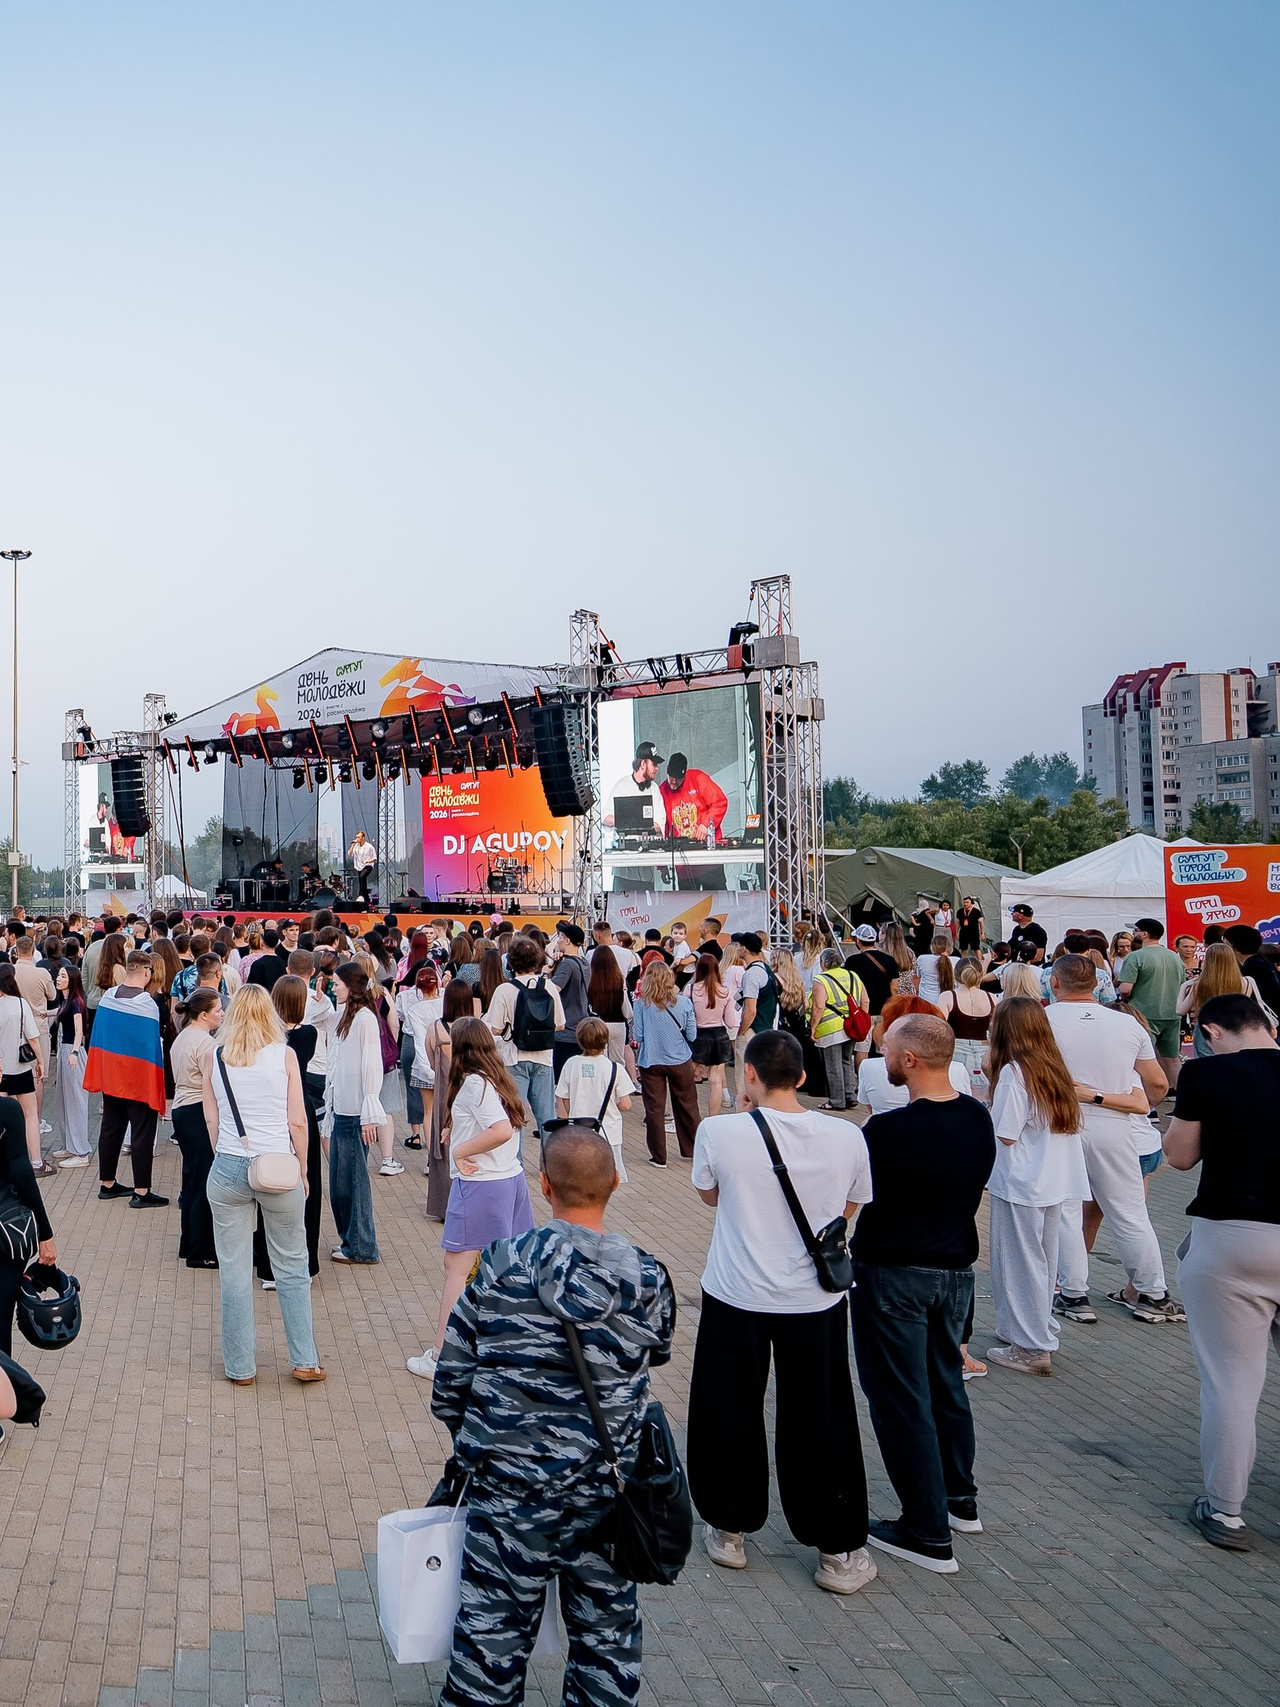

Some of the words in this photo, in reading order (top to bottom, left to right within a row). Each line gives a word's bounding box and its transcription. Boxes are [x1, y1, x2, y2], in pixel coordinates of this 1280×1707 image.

[335, 659, 363, 677] СУРГУТ
[297, 708, 322, 721] 2026
[429, 810, 448, 819] 2026
[443, 834, 465, 855] DJ
[471, 830, 569, 855] AGUPOV
[1177, 852, 1217, 864] СУРГУТ
[1178, 863, 1211, 873] ГОРОД
[1180, 870, 1236, 883] МОЛОДЫХ
[619, 905, 638, 917] ГОРИ
[1189, 898, 1218, 911] ГОРИ
[630, 914, 650, 927] ЯРКО
[1205, 908, 1237, 921] ЯРКО
